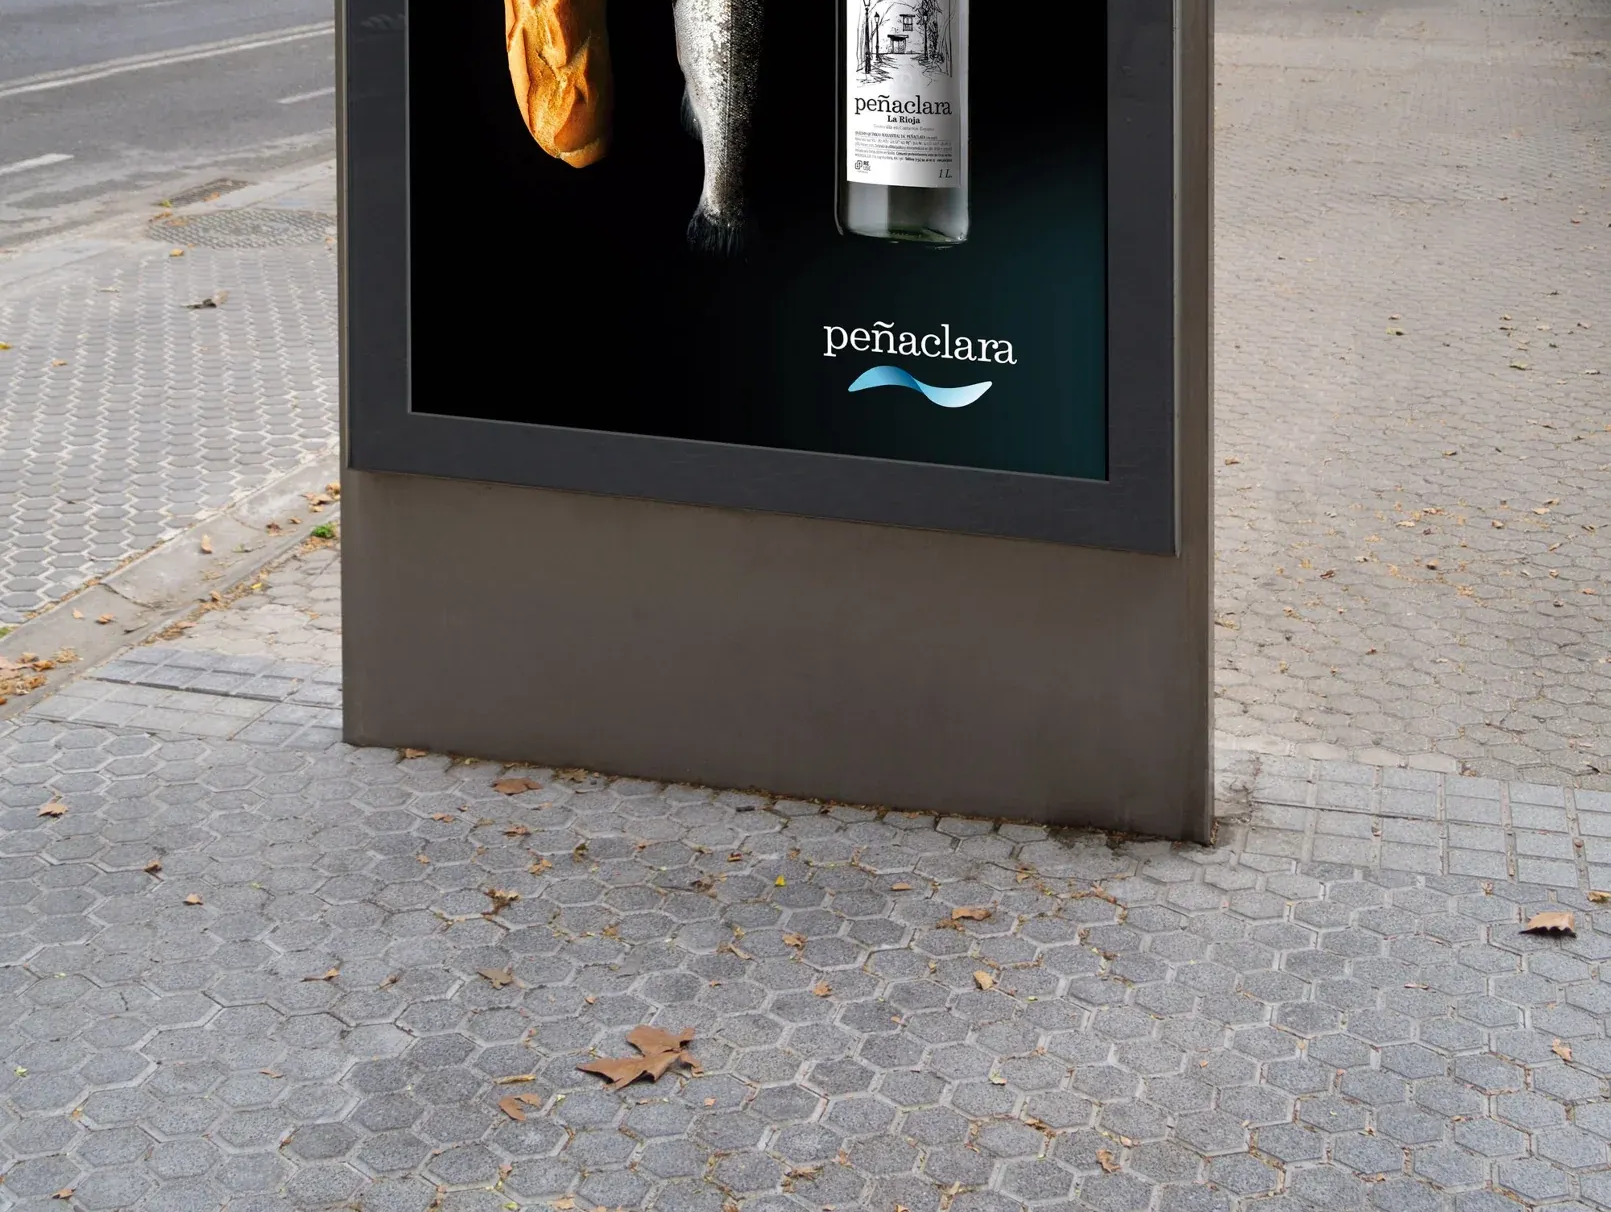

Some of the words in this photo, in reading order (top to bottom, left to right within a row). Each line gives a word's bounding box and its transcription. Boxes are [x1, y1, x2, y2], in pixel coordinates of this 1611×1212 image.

[854, 94, 953, 115] peñaclara
[887, 115, 898, 123] La
[899, 115, 921, 125] Rioja
[823, 320, 1018, 365] peñaclara
